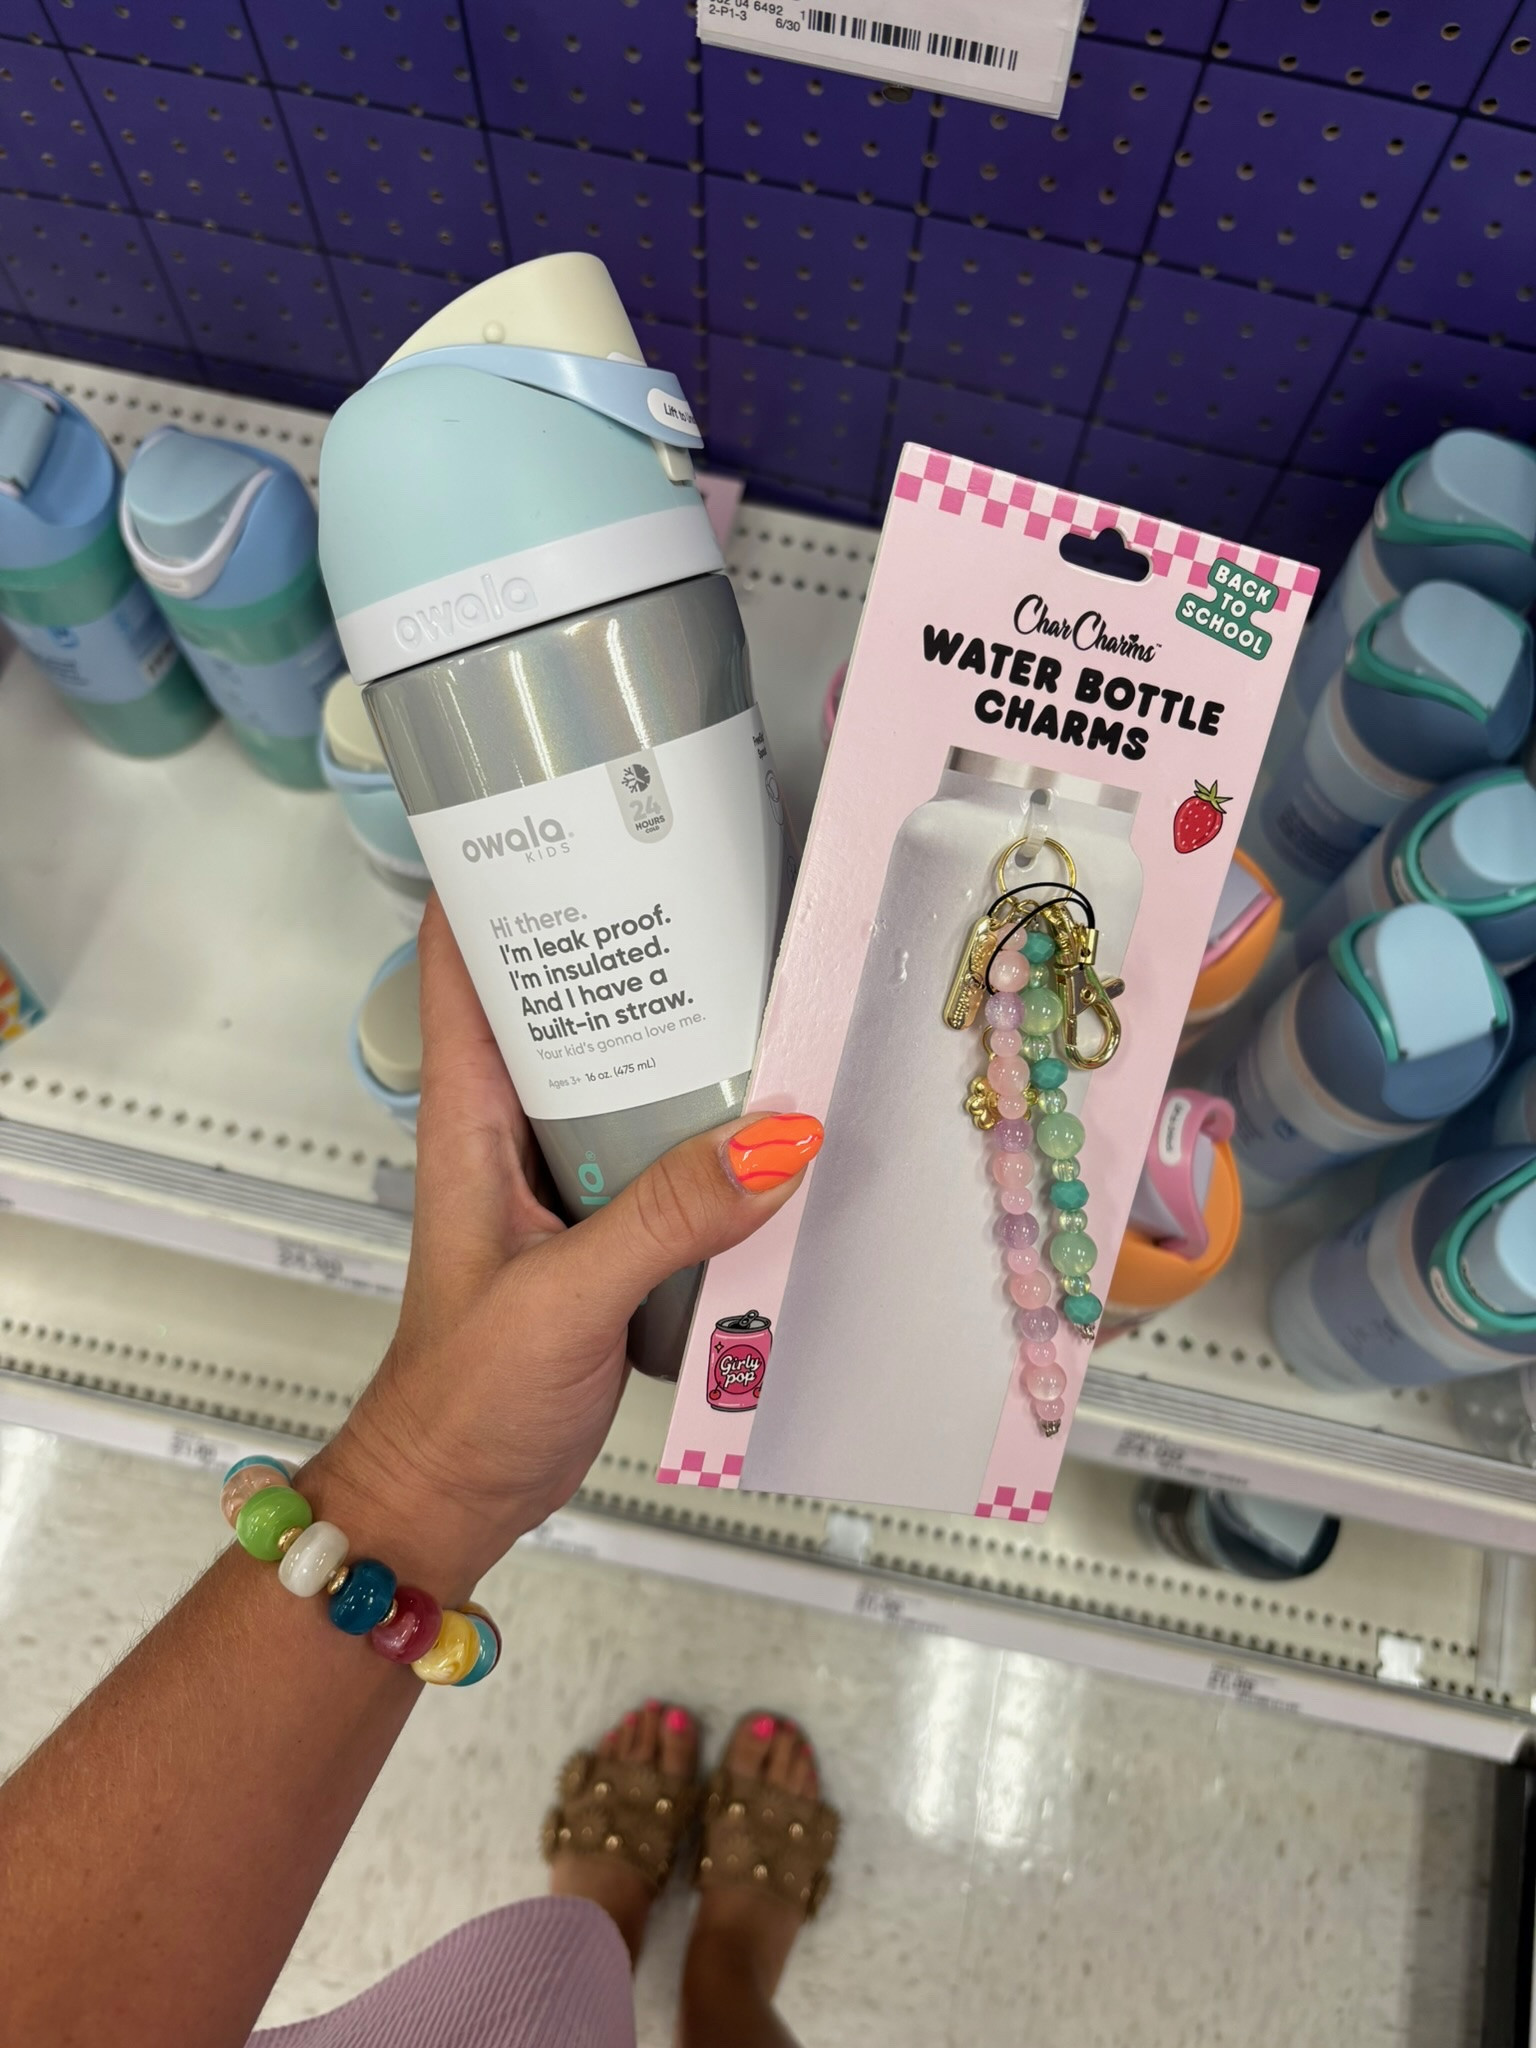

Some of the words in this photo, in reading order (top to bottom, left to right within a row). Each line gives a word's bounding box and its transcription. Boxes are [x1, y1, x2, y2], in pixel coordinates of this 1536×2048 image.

[709, 4, 748, 21] 2-P1-3
[753, 1, 784, 16] 6492
[775, 18, 801, 32] 6/30
[1214, 564, 1272, 606] BACK
[395, 573, 539, 652] owala
[1222, 592, 1248, 617] TO
[1181, 599, 1264, 656] SCHOOL
[923, 624, 1063, 694] WATER
[1074, 667, 1226, 736] BOTTLE
[974, 689, 1150, 762] CHARMS
[629, 795, 662, 822] 24
[635, 814, 666, 832] HOURS
[645, 824, 660, 834] COLD
[524, 841, 571, 864] KIDS
[489, 917, 513, 940] Hi
[515, 906, 588, 935] there.
[499, 942, 532, 966] I'm
[533, 929, 590, 959] leak
[593, 903, 672, 950] proof.
[509, 969, 542, 991] I'm
[543, 935, 671, 980] insulated.
[521, 993, 563, 1017] And
[565, 988, 577, 1009] I
[577, 973, 644, 1003] have
[650, 968, 669, 986] a
[527, 1012, 609, 1043] built-in
[615, 989, 695, 1025] straw.
[536, 1046, 564, 1062] Your
[564, 1041, 596, 1058] kid's
[598, 1030, 644, 1053] gonna
[645, 1021, 677, 1040] love
[679, 1011, 707, 1028] me.
[548, 1078, 570, 1090] Ages
[569, 1075, 582, 1086] 3+
[584, 1071, 596, 1083] 16
[597, 1069, 613, 1080] oz.
[613, 1062, 636, 1078] (475
[636, 1056, 657, 1072] mL)
[720, 1354, 760, 1376] Girly
[724, 1370, 756, 1389] pop
